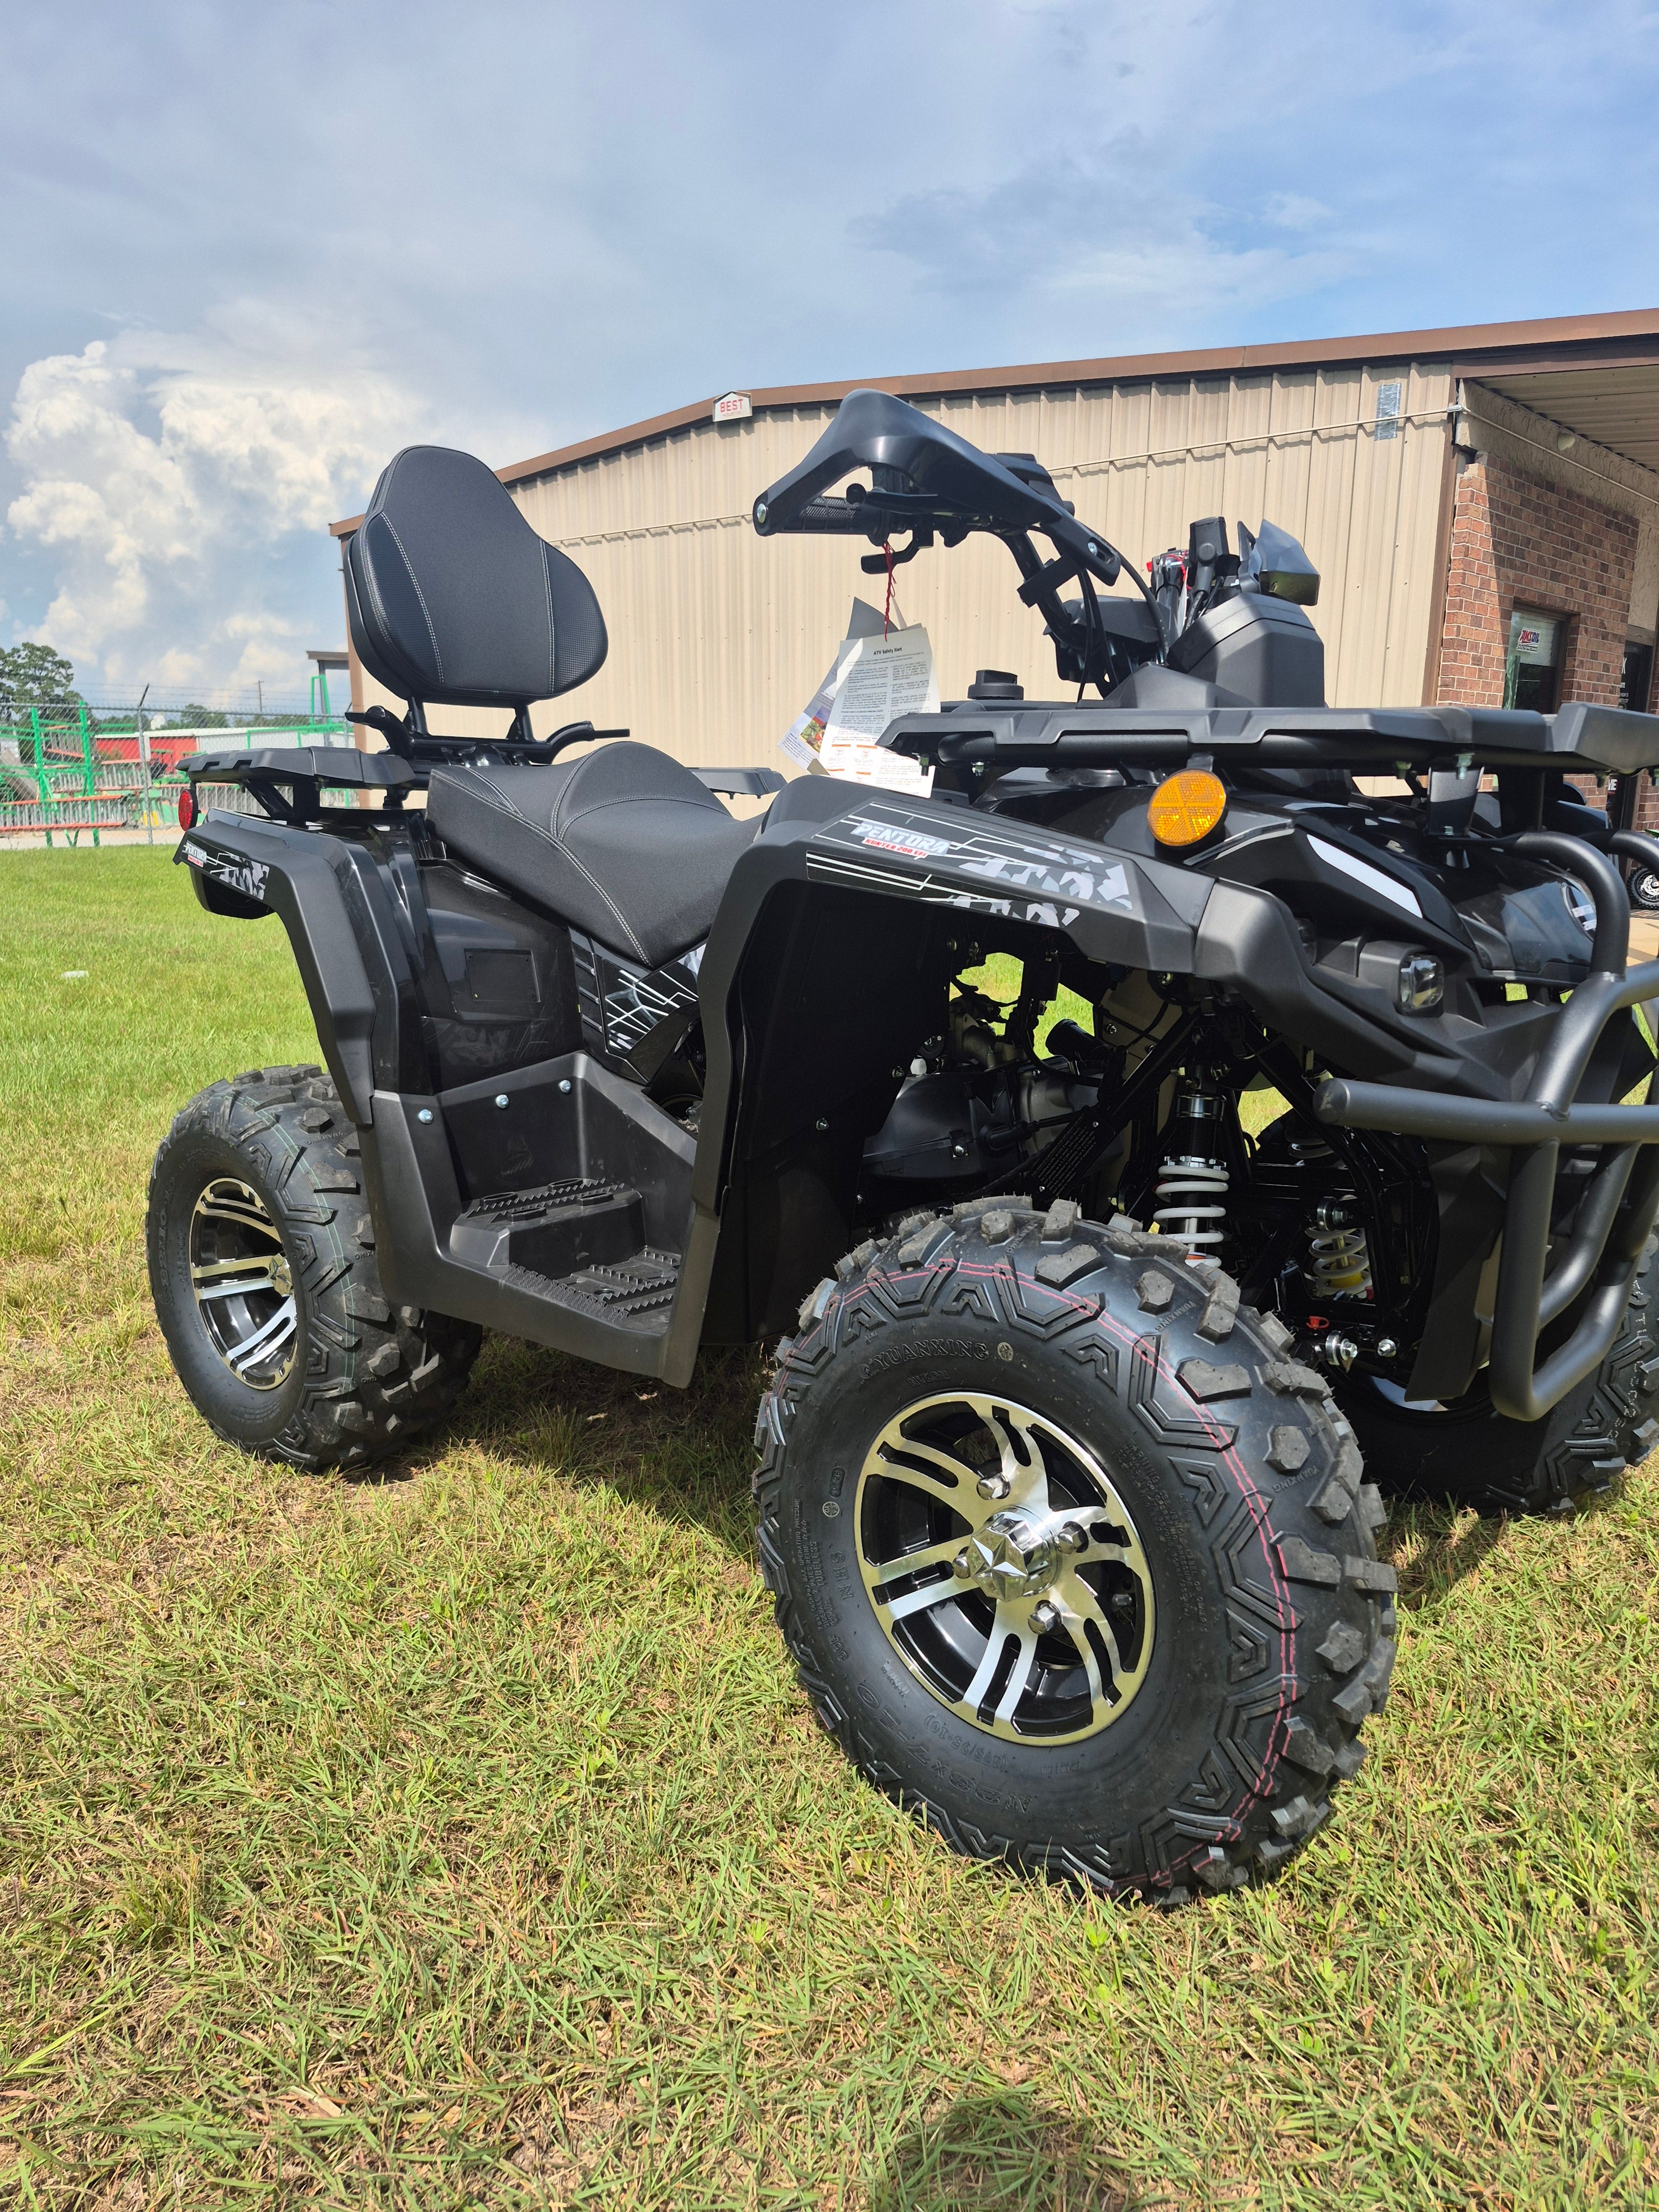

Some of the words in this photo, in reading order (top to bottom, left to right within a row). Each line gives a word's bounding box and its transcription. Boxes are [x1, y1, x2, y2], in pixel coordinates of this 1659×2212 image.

[720, 399, 743, 413] BEST
[1520, 630, 1540, 643] AMSOIL
[857, 823, 949, 853] PENTORA
[874, 1339, 989, 1370] YUANXING
[907, 1370, 951, 1387] NYLON
[1272, 1465, 1319, 1493] YUANXING
[795, 1531, 805, 1566] OPERATING
[1185, 1549, 1198, 1575] LABEL
[808, 1567, 816, 1587] PLIES
[810, 1541, 825, 1586] TUBELESS
[831, 1551, 854, 1600] NHS
[815, 1597, 830, 1629] SIDEWALL
